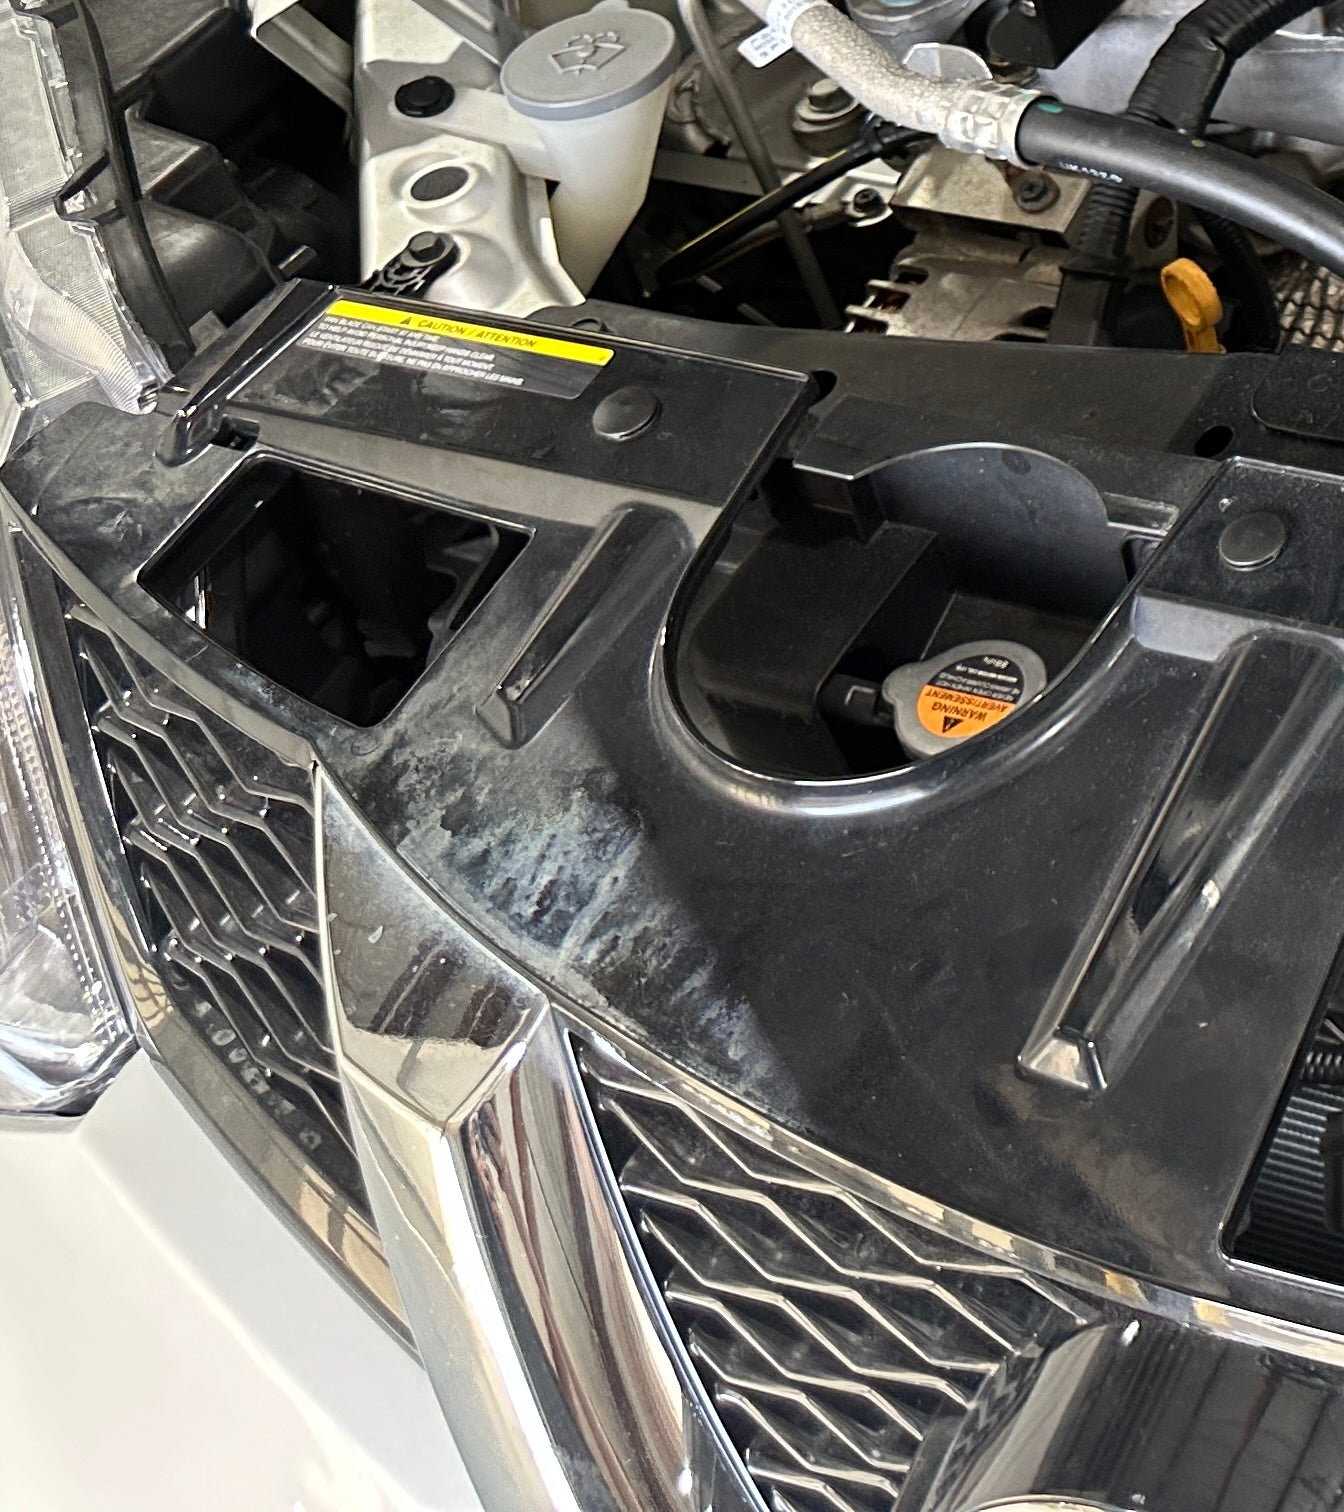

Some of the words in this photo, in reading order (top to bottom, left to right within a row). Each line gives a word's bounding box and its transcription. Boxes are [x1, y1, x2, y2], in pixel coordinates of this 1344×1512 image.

[418, 319, 466, 335] CAUTION
[475, 330, 539, 348] ATTENTION
[925, 688, 1008, 713] AVERTISSEMENT
[931, 702, 987, 721] WARNING
